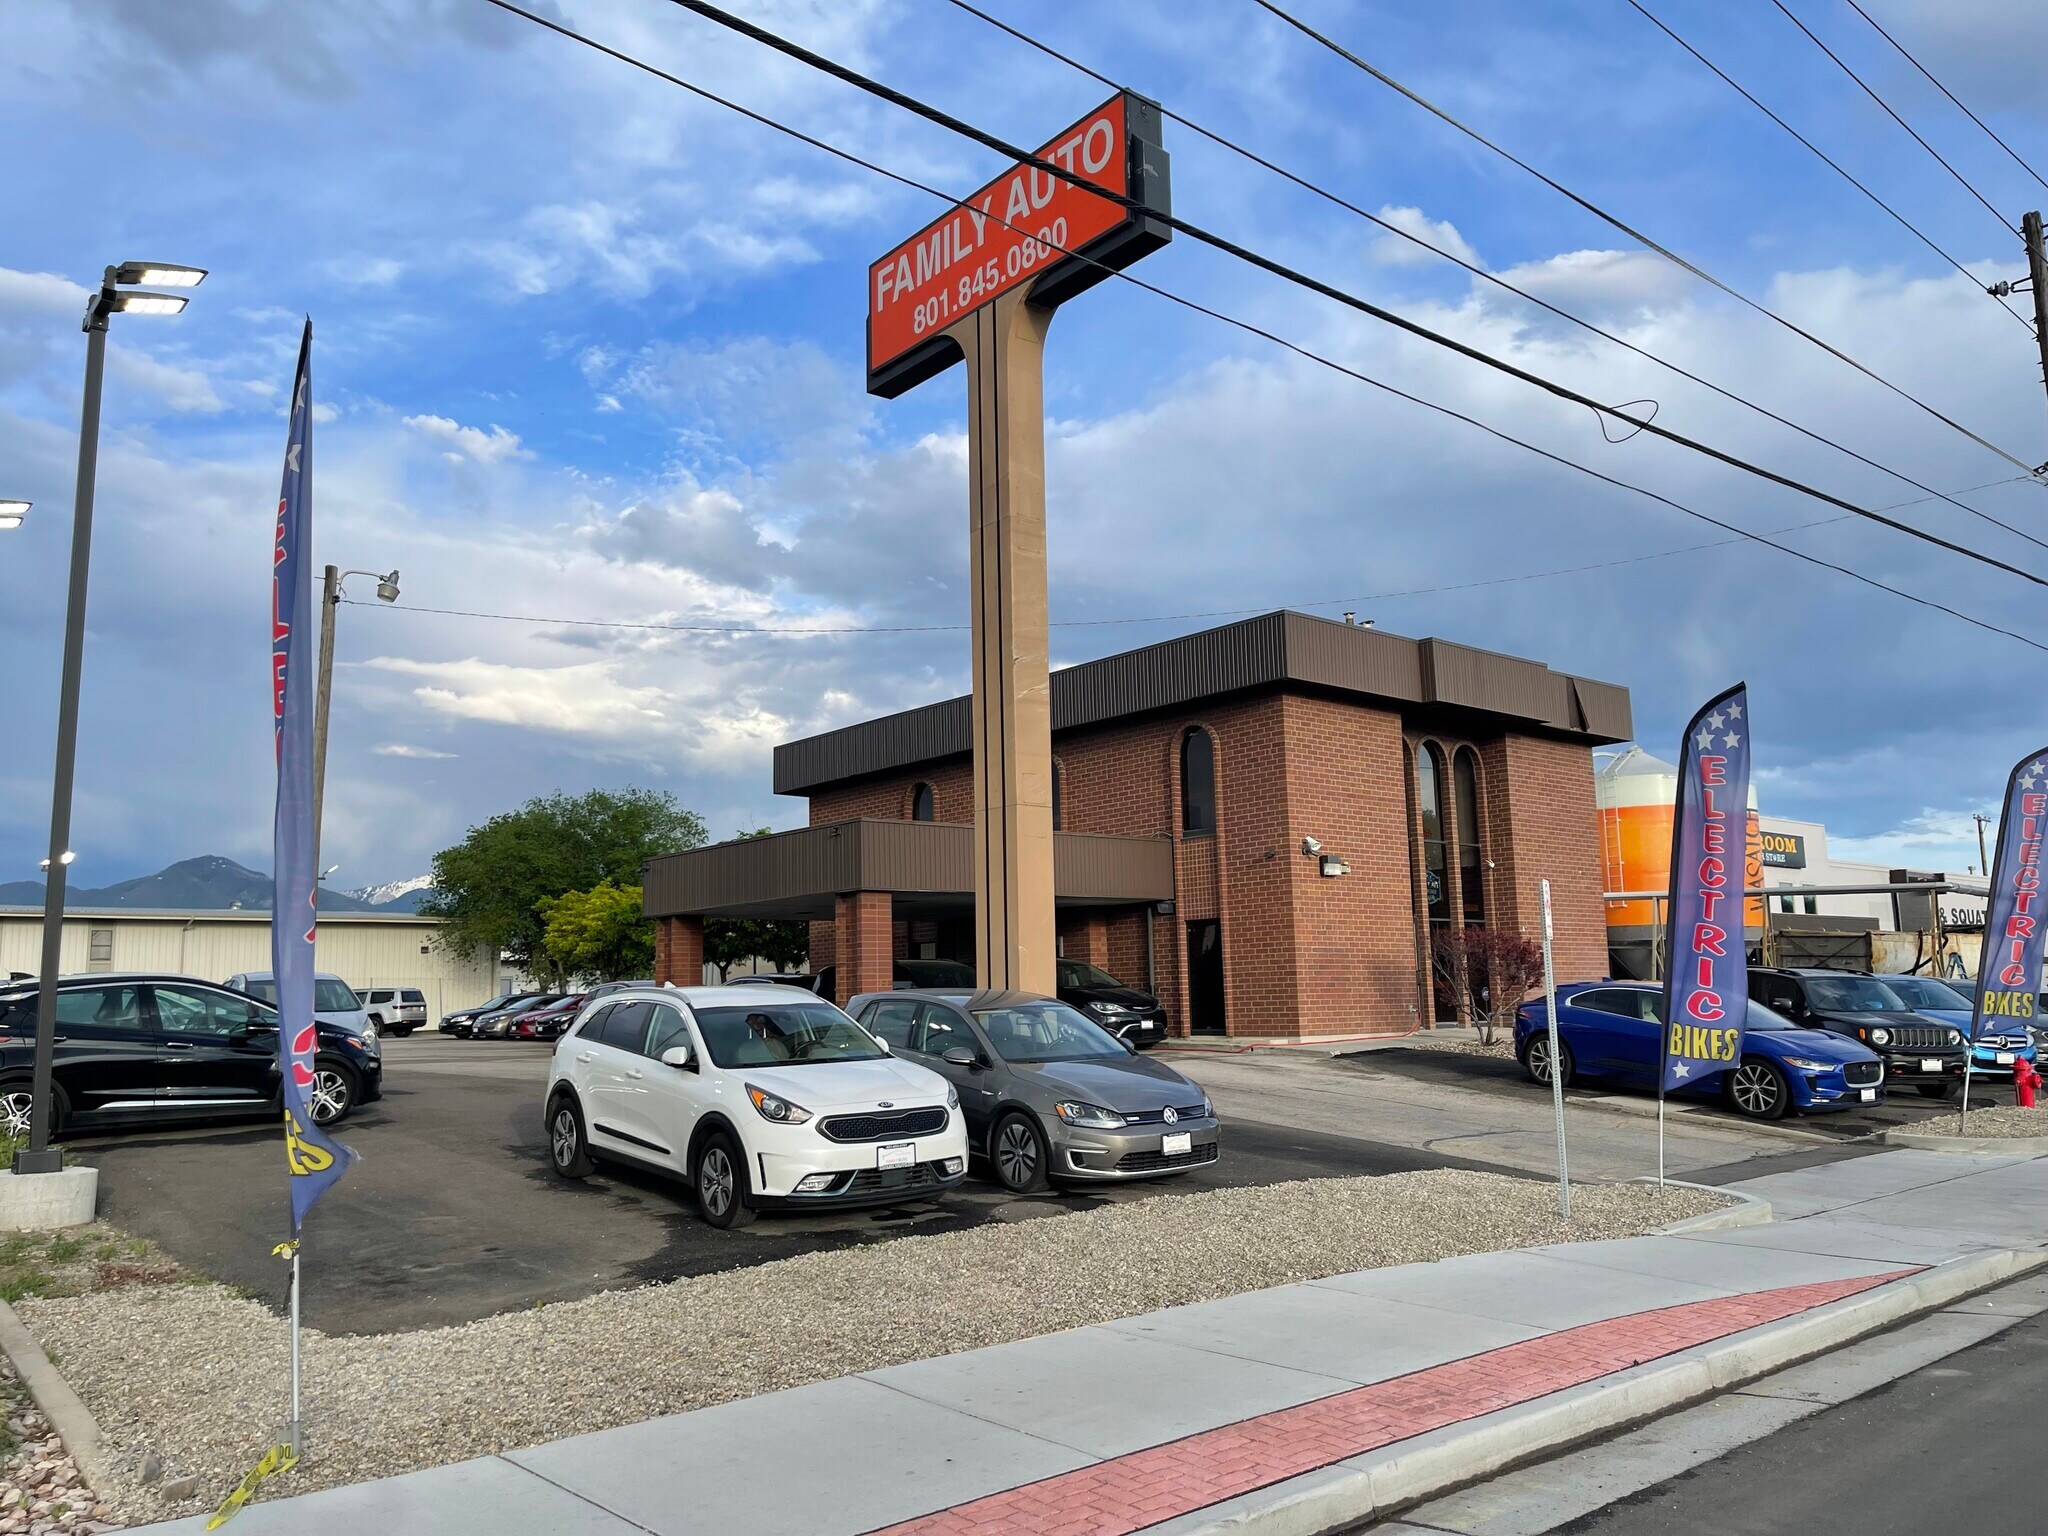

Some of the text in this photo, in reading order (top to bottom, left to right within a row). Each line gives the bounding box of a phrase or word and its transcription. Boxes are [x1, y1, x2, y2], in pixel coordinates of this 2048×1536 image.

[877, 118, 1114, 313] FAMILY AUTO
[913, 216, 1068, 335] 801.845.0800
[1686, 755, 1728, 1021] ELECTRIC
[1999, 793, 2047, 985] ELECTRIC
[1669, 1022, 1739, 1062] BIKES
[1983, 990, 2034, 1019] BIKES
